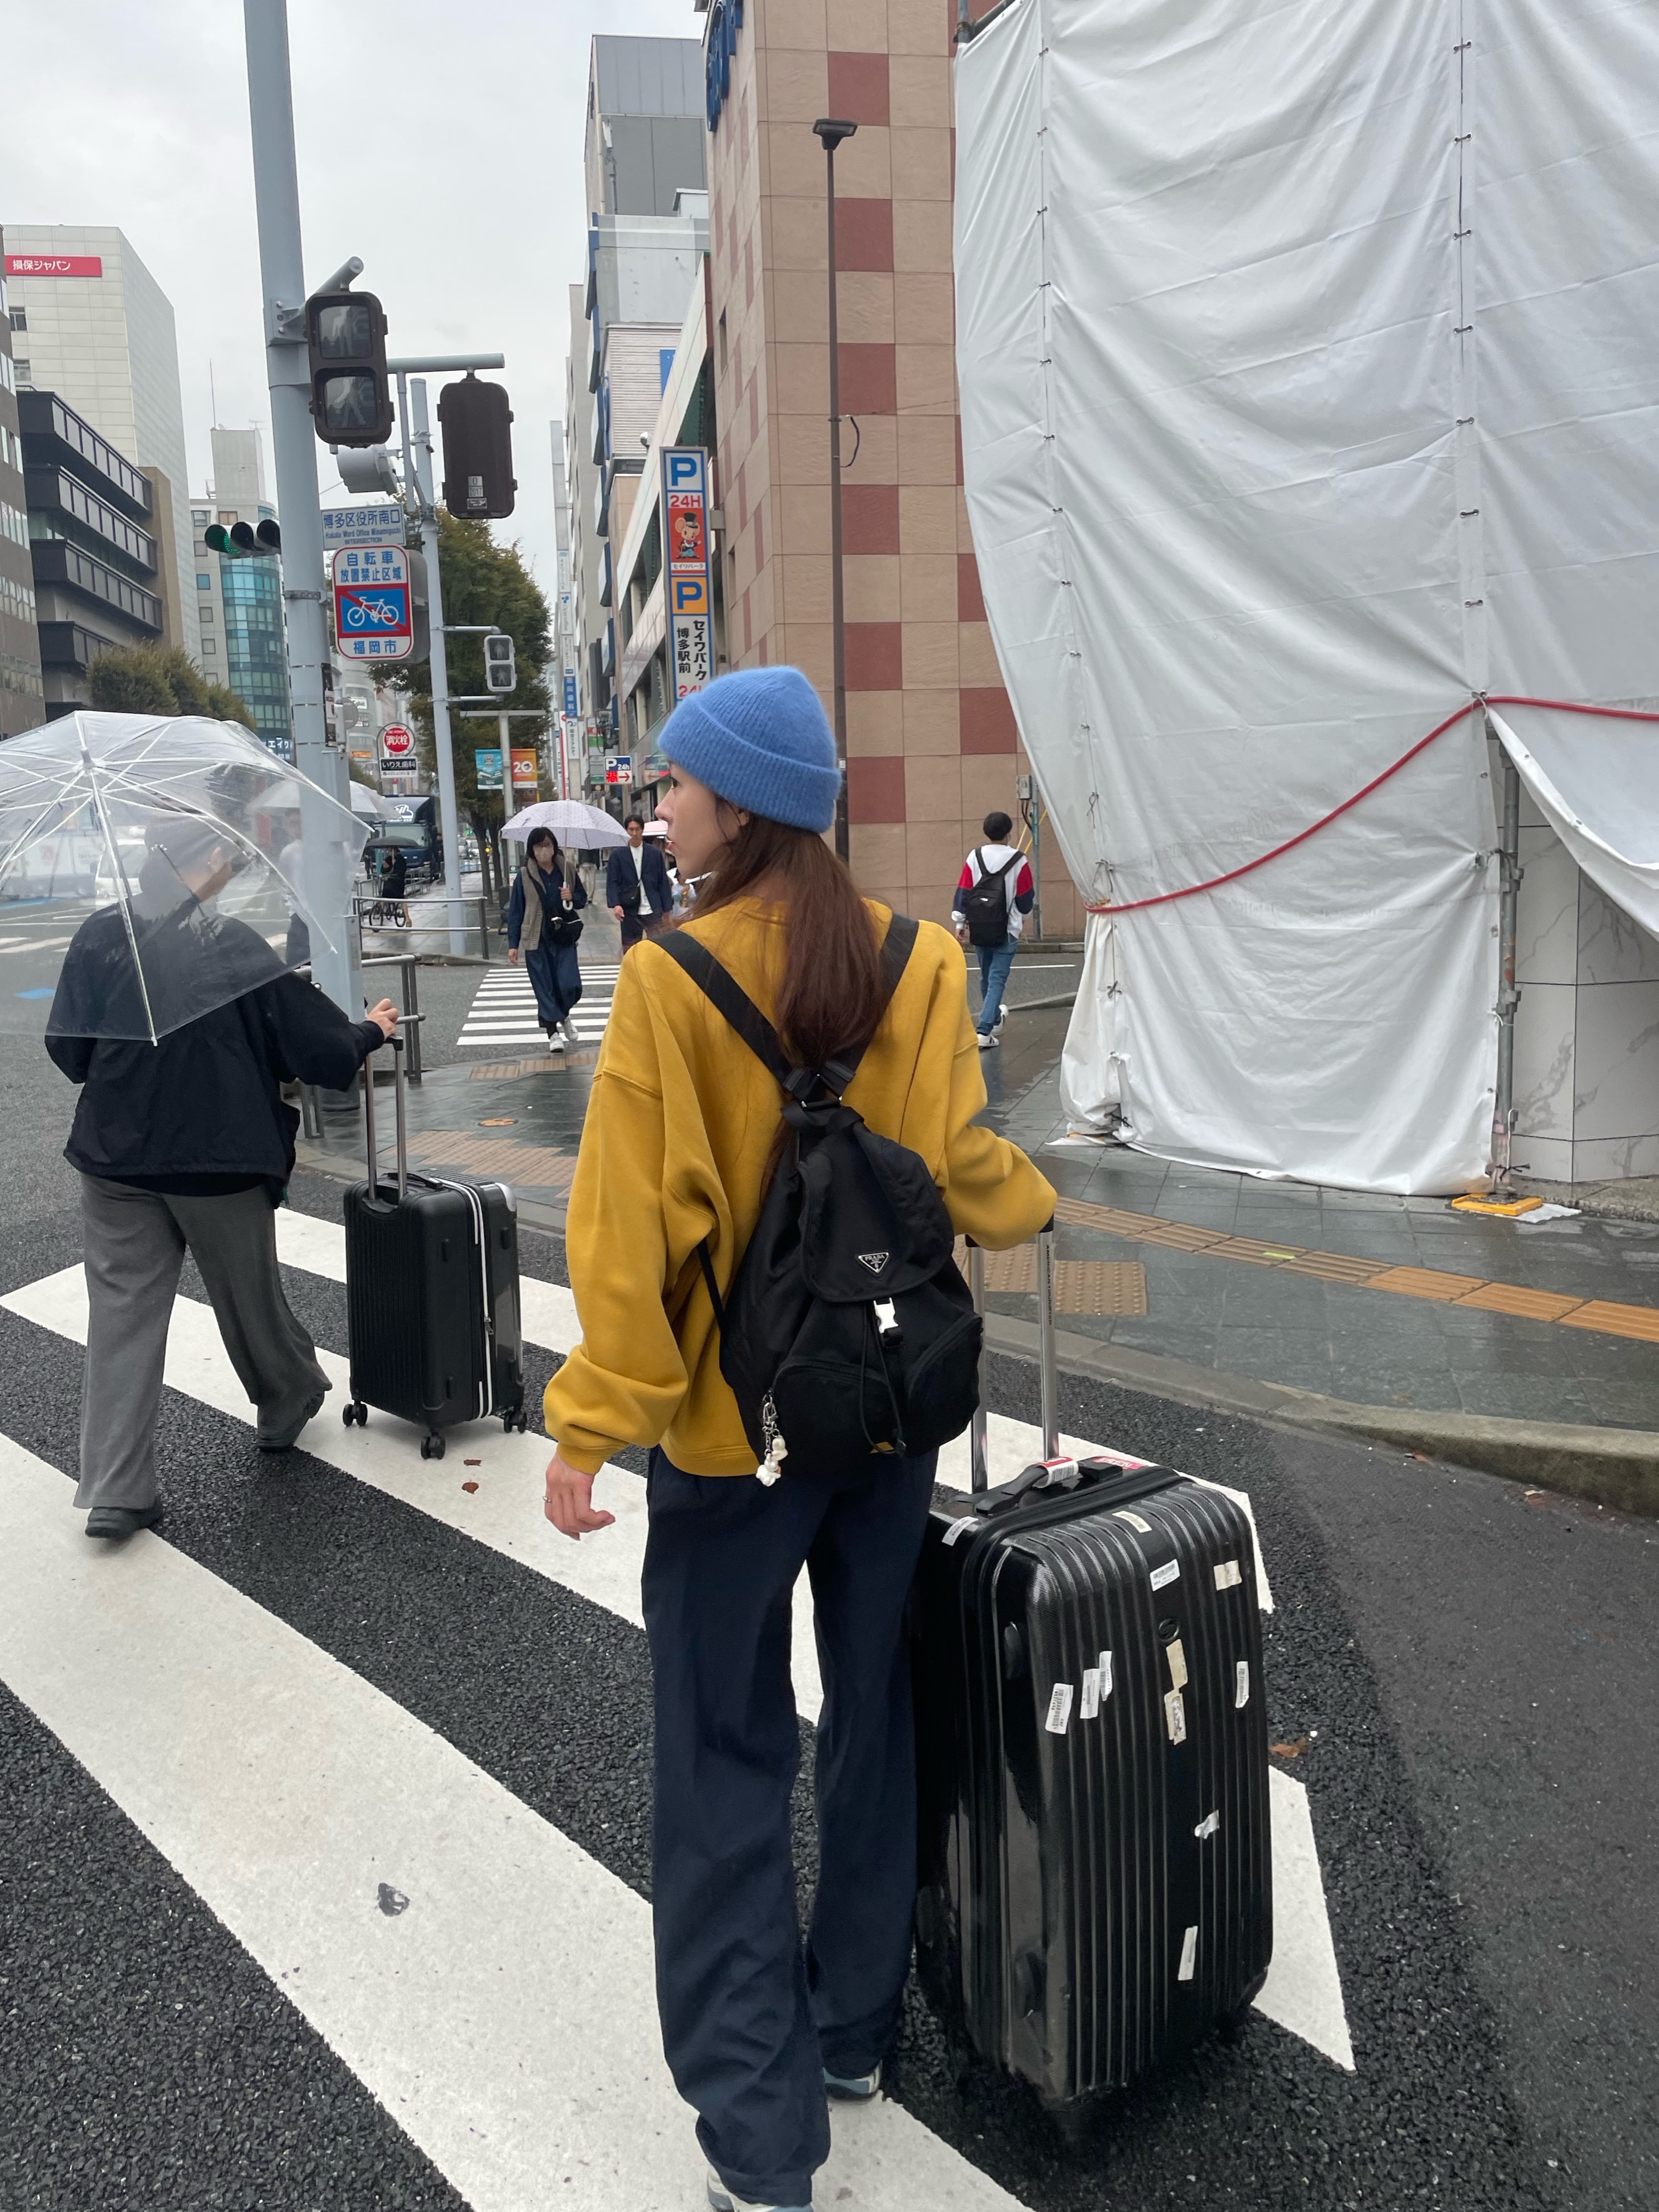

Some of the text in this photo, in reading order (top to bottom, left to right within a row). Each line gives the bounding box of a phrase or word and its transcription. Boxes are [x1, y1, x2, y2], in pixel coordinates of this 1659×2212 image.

[13, 259, 71, 271] 損保ジャパン
[670, 457, 697, 486] P
[670, 495, 700, 507] 24H
[323, 509, 401, 529] 博多区役所南口
[347, 551, 393, 567] 自転車
[340, 567, 402, 583] 放置禁止区域
[676, 581, 703, 609] P
[353, 639, 397, 654] 福岡市
[676, 628, 691, 673] 博多駅前
[693, 620, 707, 681] セイワパーク
[386, 735, 409, 746] 消火栓
[606, 758, 617, 771] P
